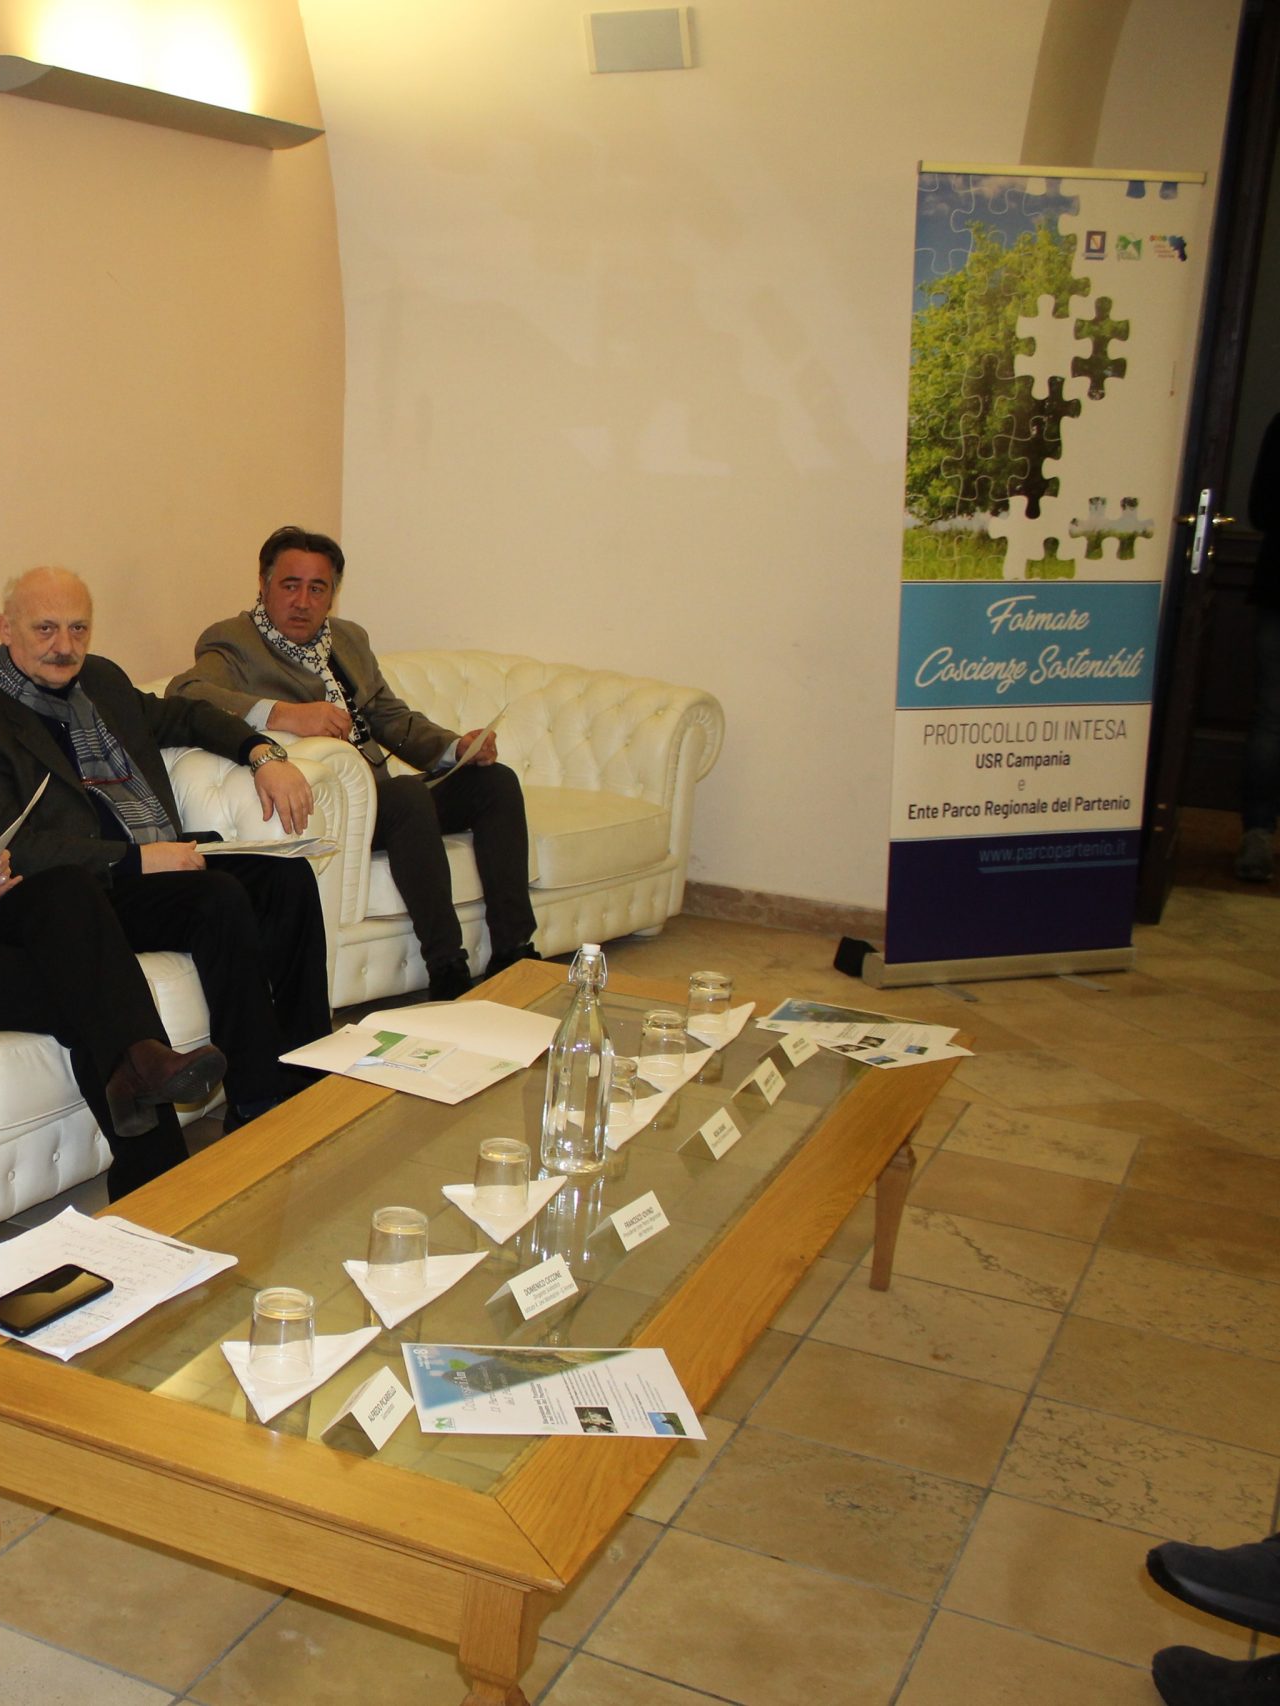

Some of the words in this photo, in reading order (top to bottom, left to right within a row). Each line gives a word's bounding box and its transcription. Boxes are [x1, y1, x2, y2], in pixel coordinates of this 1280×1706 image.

[986, 595, 1090, 634] Formare
[915, 647, 1027, 693] Coscienze
[1029, 645, 1144, 685] Sostenibili
[923, 721, 1037, 745] PROTOCOLLO
[1042, 720, 1058, 741] DI
[1064, 719, 1127, 741] INTESA
[975, 752, 1002, 769] USR
[1006, 751, 1071, 770] Campania
[1017, 779, 1026, 791] e
[908, 803, 939, 820] Ente
[942, 802, 981, 818] Parco
[984, 798, 1048, 819] Regionale
[1051, 797, 1071, 813] del
[1074, 795, 1131, 812] Partenio
[978, 839, 1127, 863] www.parcopartenio.it
